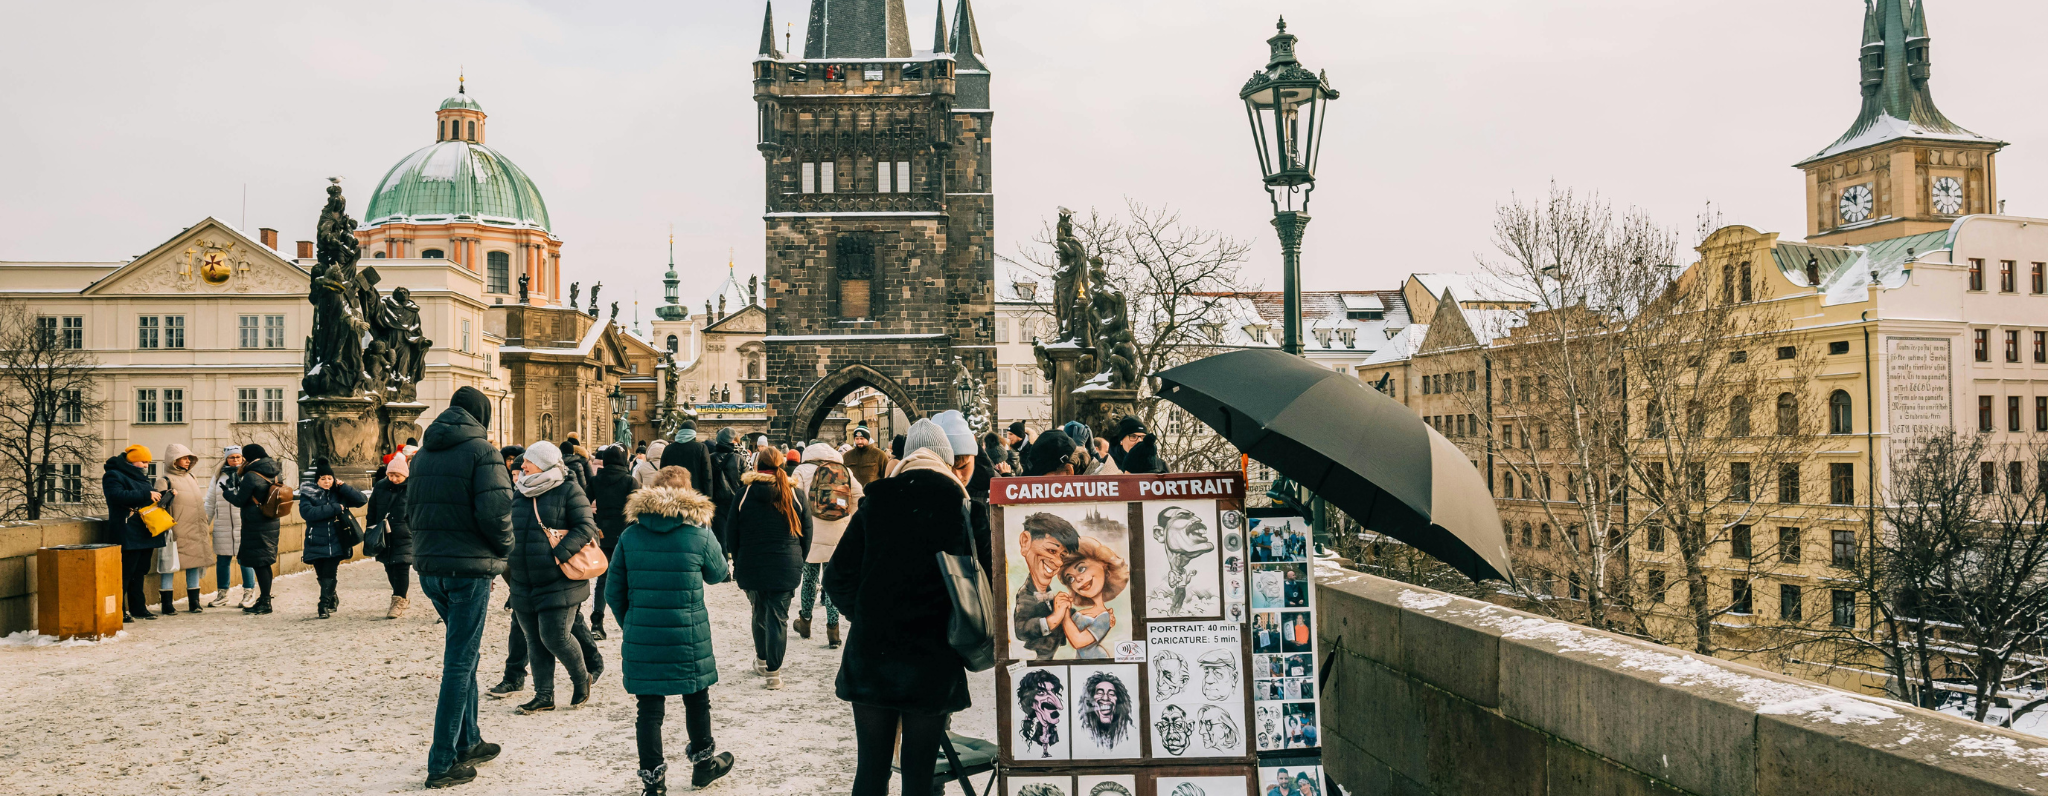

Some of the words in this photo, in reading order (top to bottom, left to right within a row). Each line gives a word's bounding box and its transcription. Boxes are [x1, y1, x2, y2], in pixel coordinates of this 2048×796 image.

[1005, 482, 1119, 500] CARICATURE
[1139, 478, 1234, 496] PORTRAIT
[1150, 624, 1205, 633] PORTRAIT:
[1151, 636, 1210, 644] CARICATURE:
[1221, 635, 1238, 643] min.
